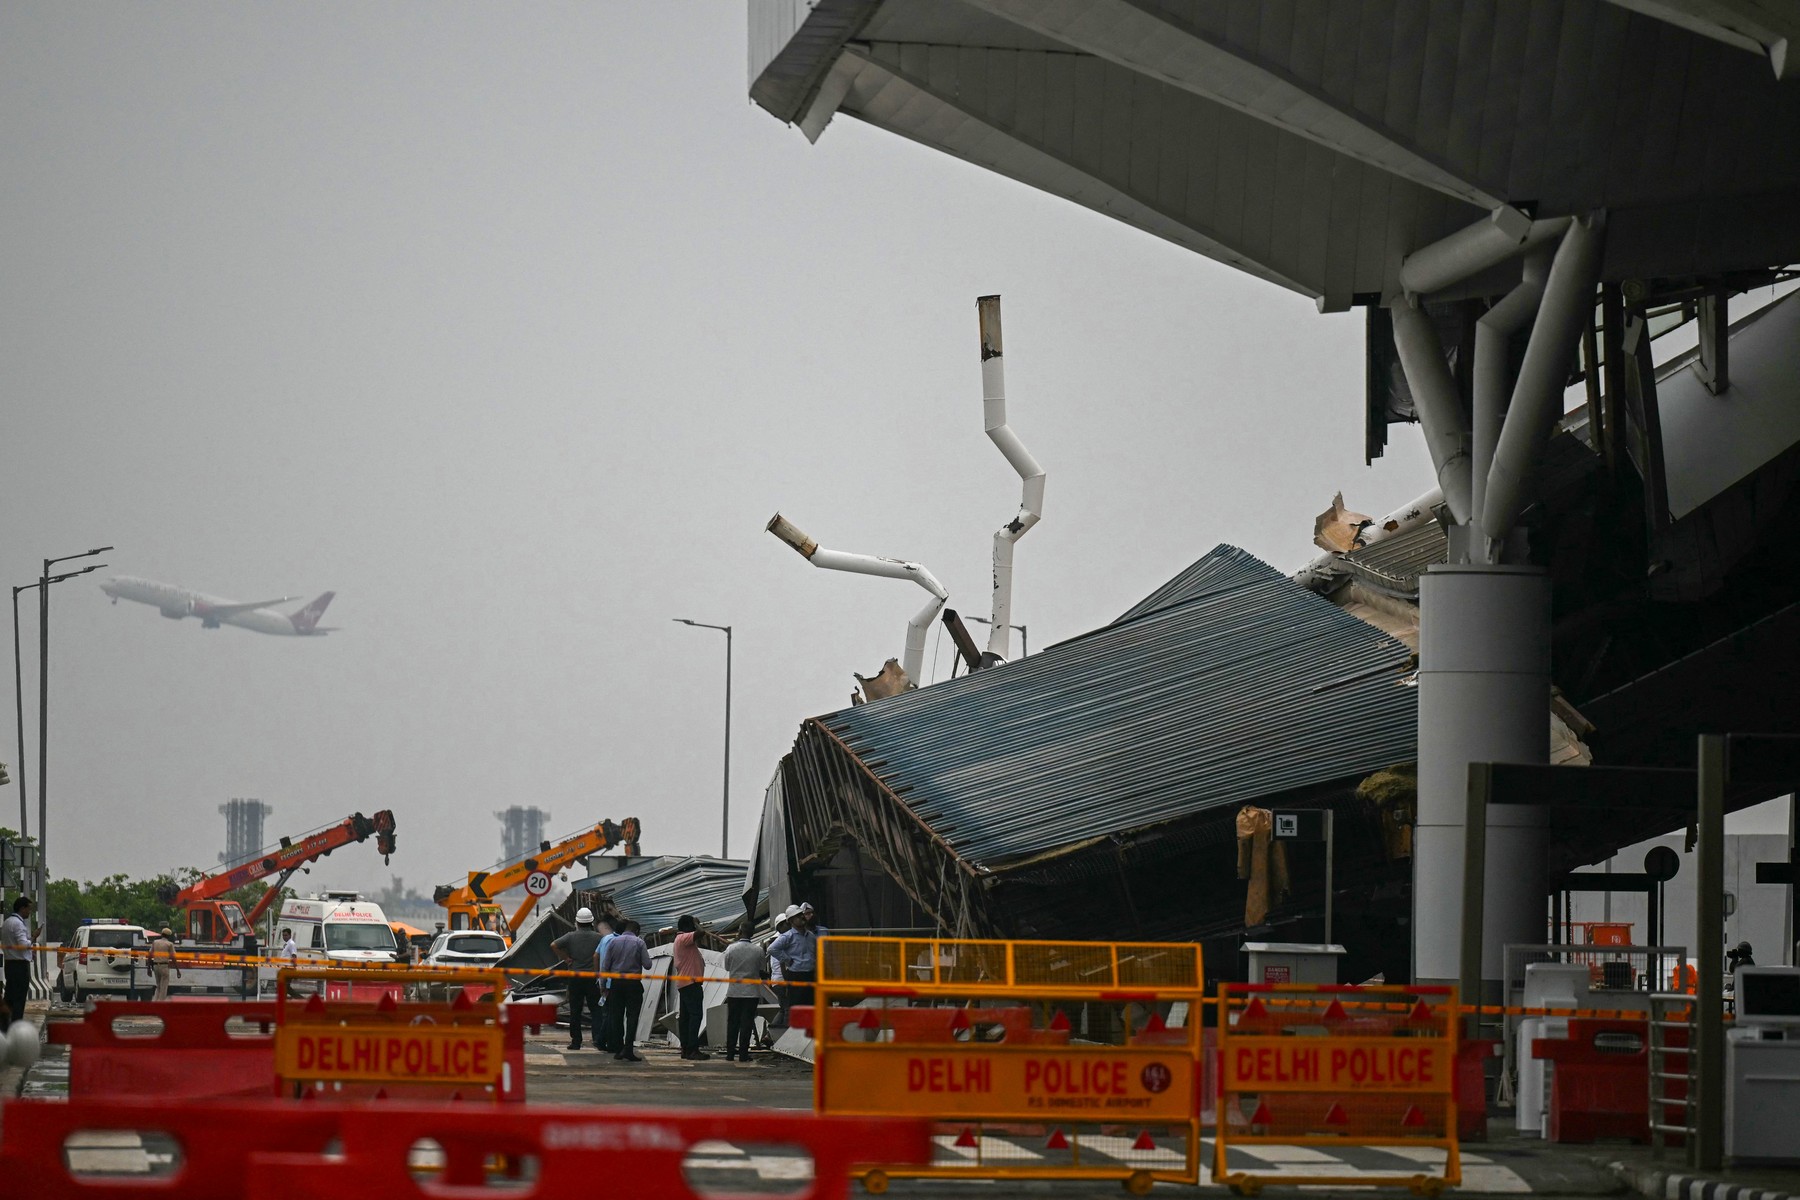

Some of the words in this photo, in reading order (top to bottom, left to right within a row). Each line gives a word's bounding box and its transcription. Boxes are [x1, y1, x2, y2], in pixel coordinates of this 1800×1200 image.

[529, 876, 546, 889] 20
[298, 1037, 380, 1072] DELHI
[386, 1038, 489, 1075] POLICE
[1236, 1047, 1319, 1082] DELHI
[1331, 1048, 1434, 1082] POLICE
[908, 1058, 991, 1092] DELHI
[1025, 1060, 1128, 1095] POLICE
[1048, 1097, 1101, 1108] DOMESTIC
[1104, 1097, 1152, 1108] AIRPORT
